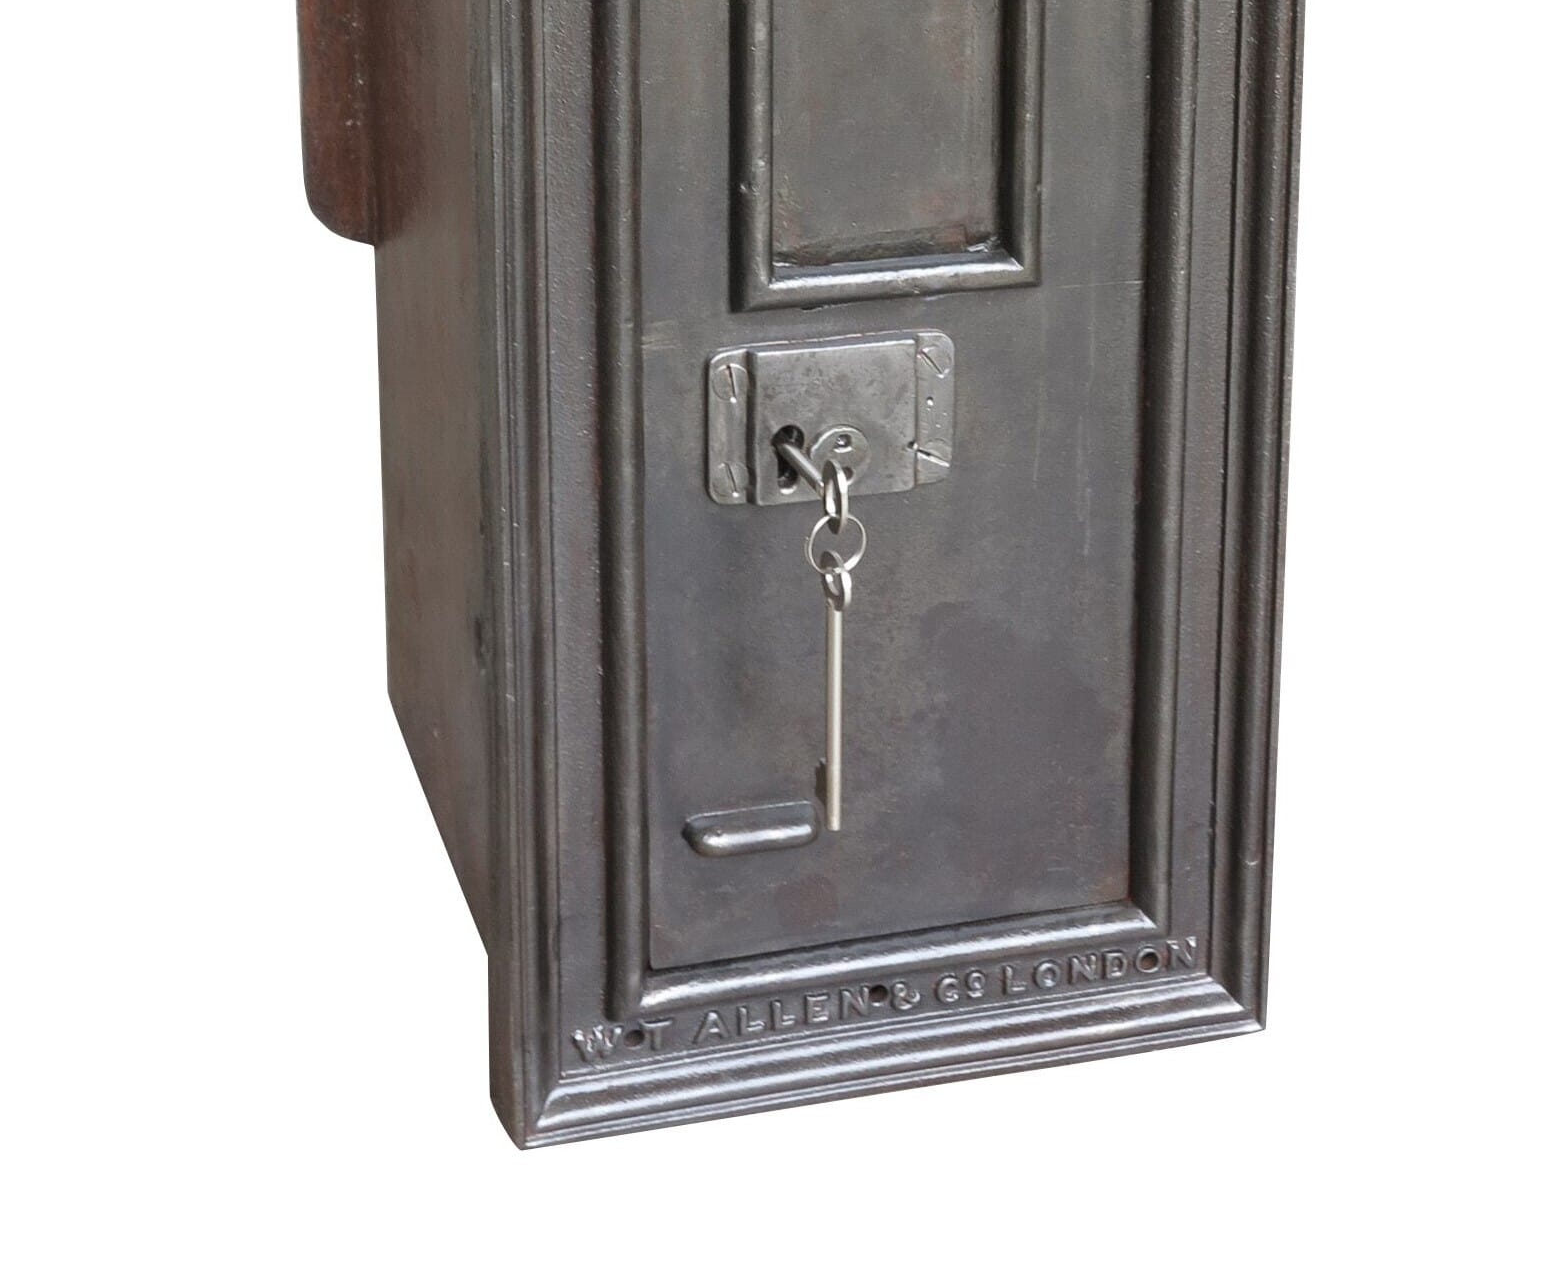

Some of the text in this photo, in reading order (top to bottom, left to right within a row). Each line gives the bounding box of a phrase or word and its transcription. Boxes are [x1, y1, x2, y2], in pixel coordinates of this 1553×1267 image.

[691, 983, 870, 1046] ALLEN
[890, 979, 921, 1012] &
[1001, 935, 1198, 996] LONDON
